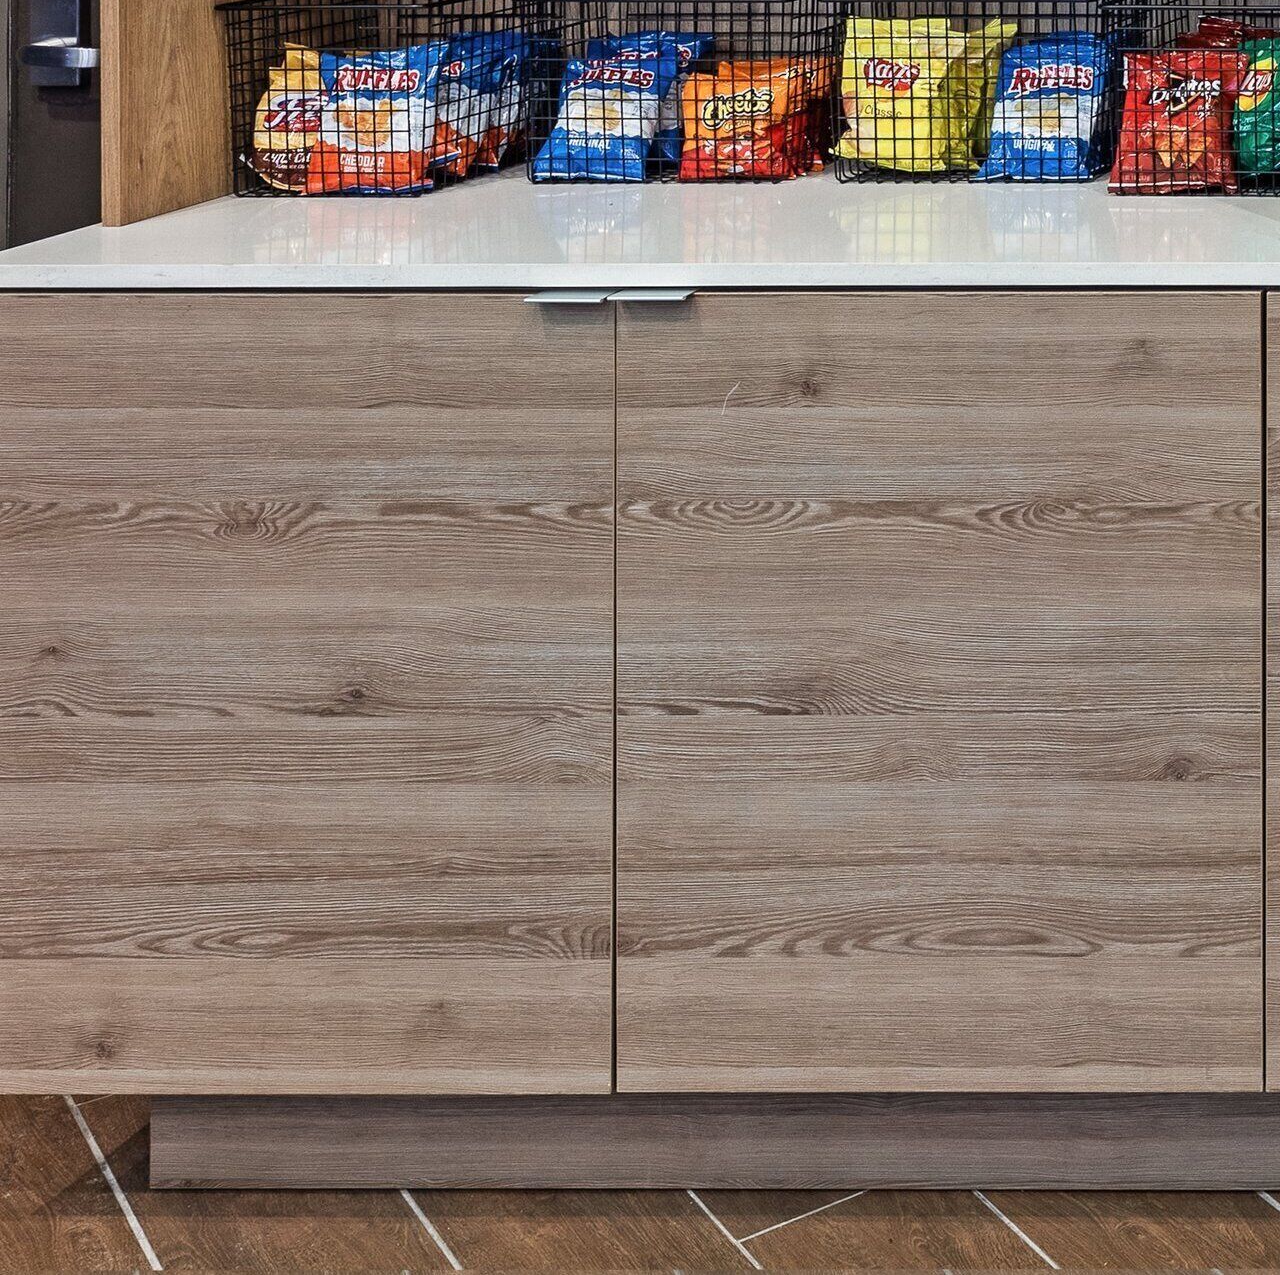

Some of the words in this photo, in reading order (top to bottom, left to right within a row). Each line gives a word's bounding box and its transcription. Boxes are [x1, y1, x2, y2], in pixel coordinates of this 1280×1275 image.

[1010, 64, 1095, 95] RUFFLES
[864, 104, 903, 118] Classic
[340, 153, 385, 167] CHEDDAR
